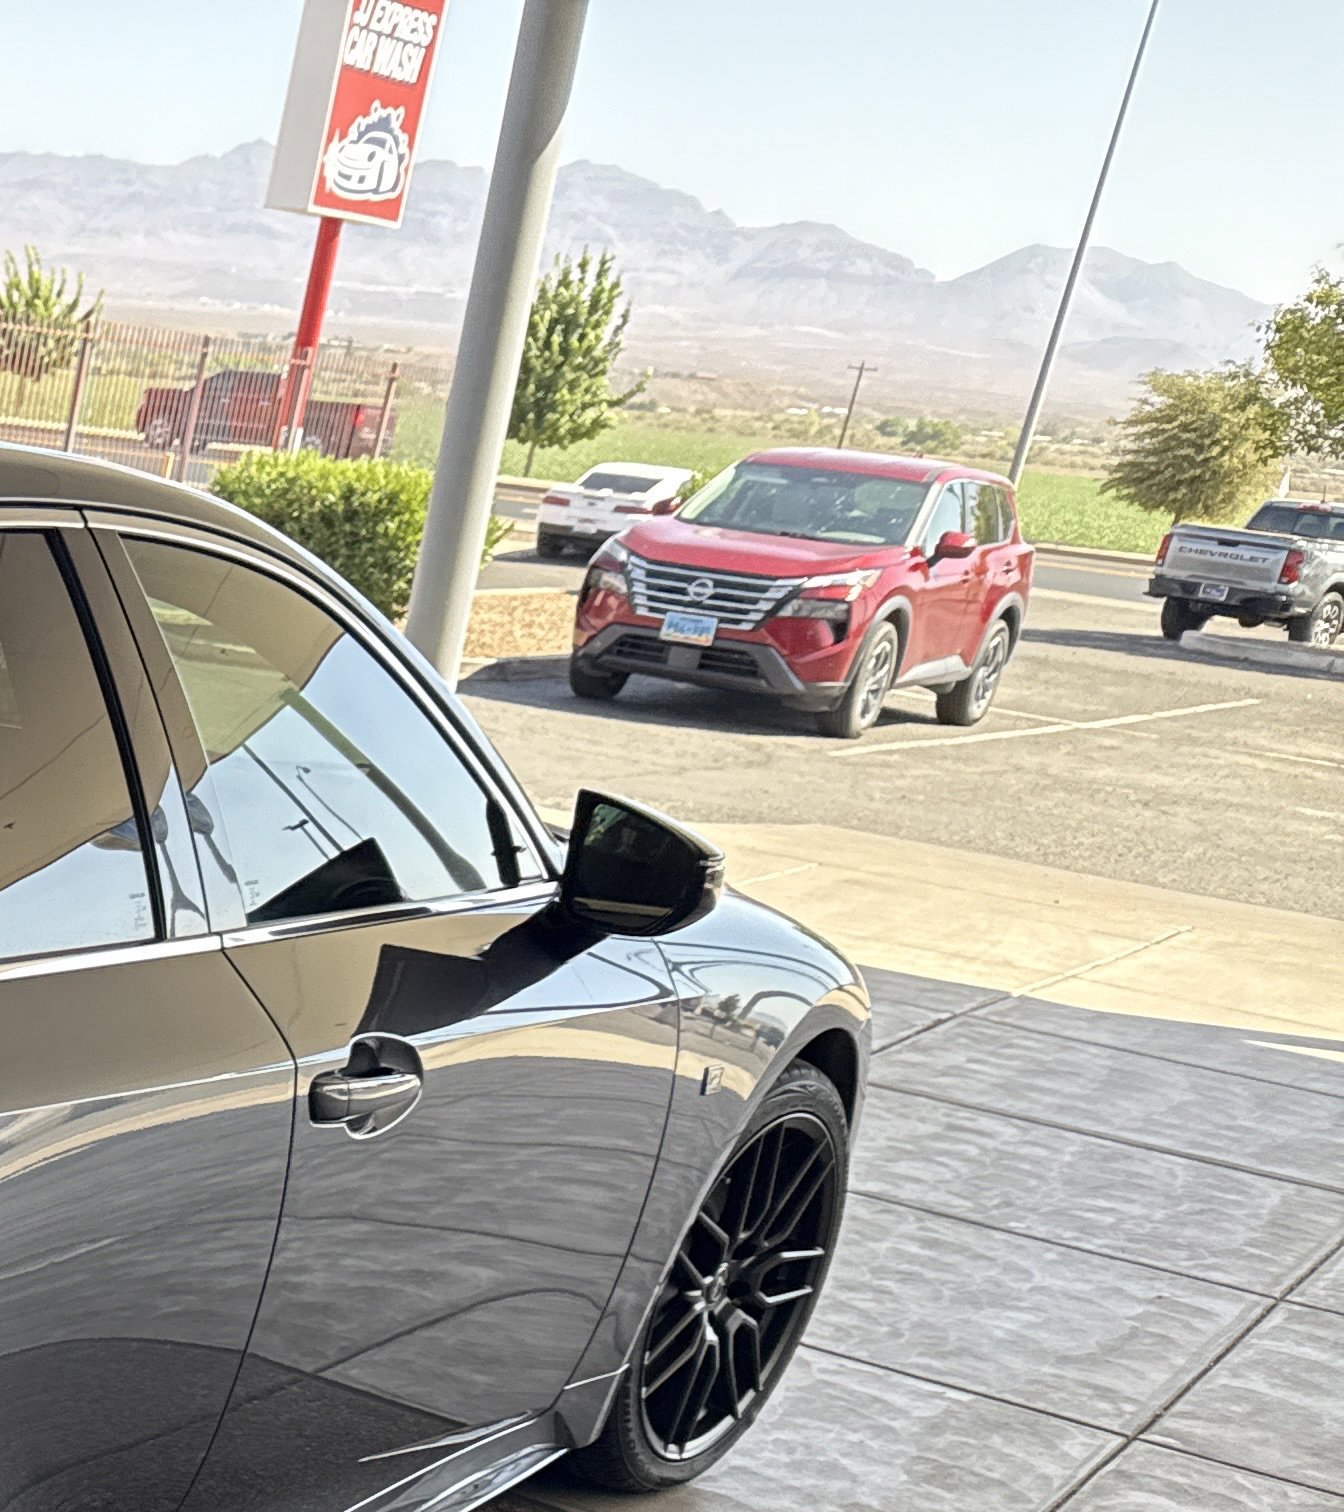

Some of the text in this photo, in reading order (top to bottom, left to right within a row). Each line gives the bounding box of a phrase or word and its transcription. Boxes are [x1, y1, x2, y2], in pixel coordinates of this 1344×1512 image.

[368, 0, 438, 47] EXPRESS
[343, 25, 426, 84] CAR WASH
[1178, 546, 1271, 564] CHEVROLET
